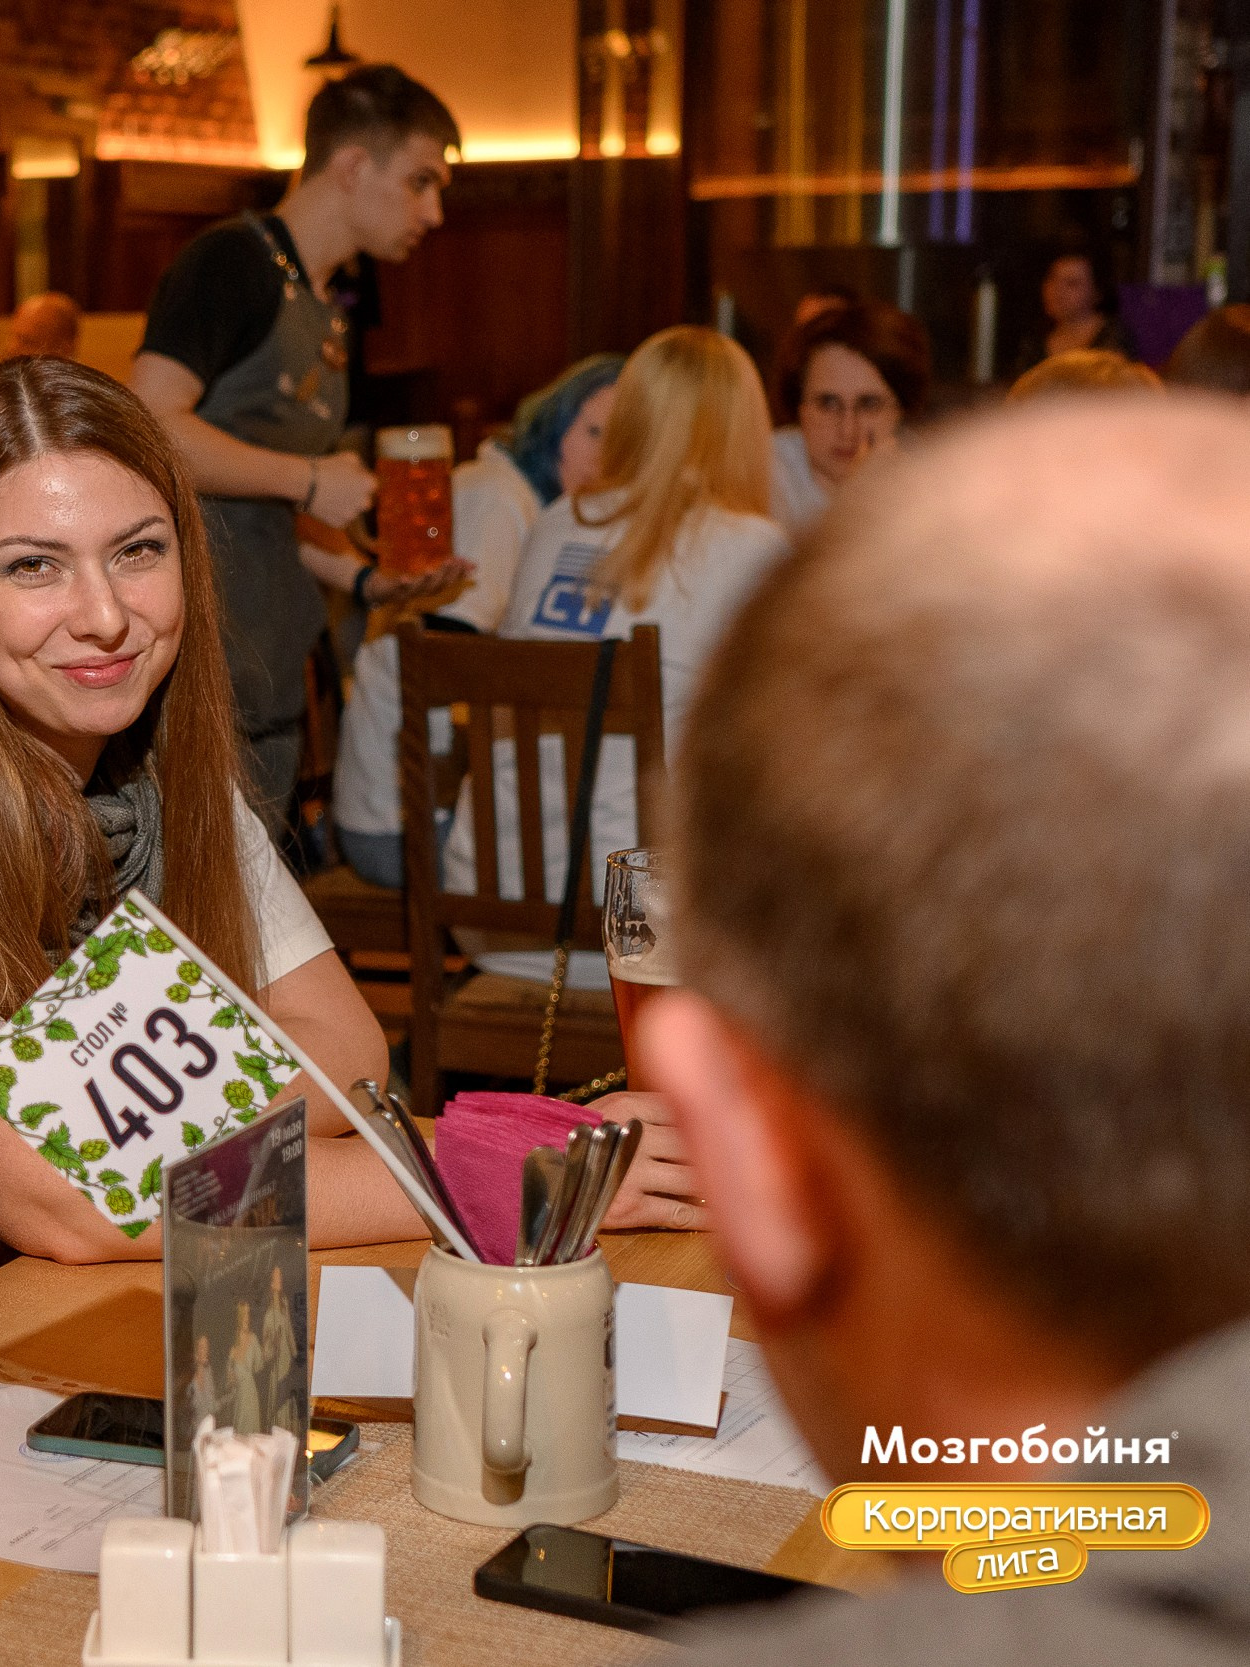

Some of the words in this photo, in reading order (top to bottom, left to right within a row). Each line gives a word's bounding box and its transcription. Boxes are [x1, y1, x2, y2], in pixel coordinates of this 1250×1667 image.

[70, 1020, 115, 1067] СТОЛ
[107, 1001, 129, 1028] №
[83, 1006, 218, 1150] 403
